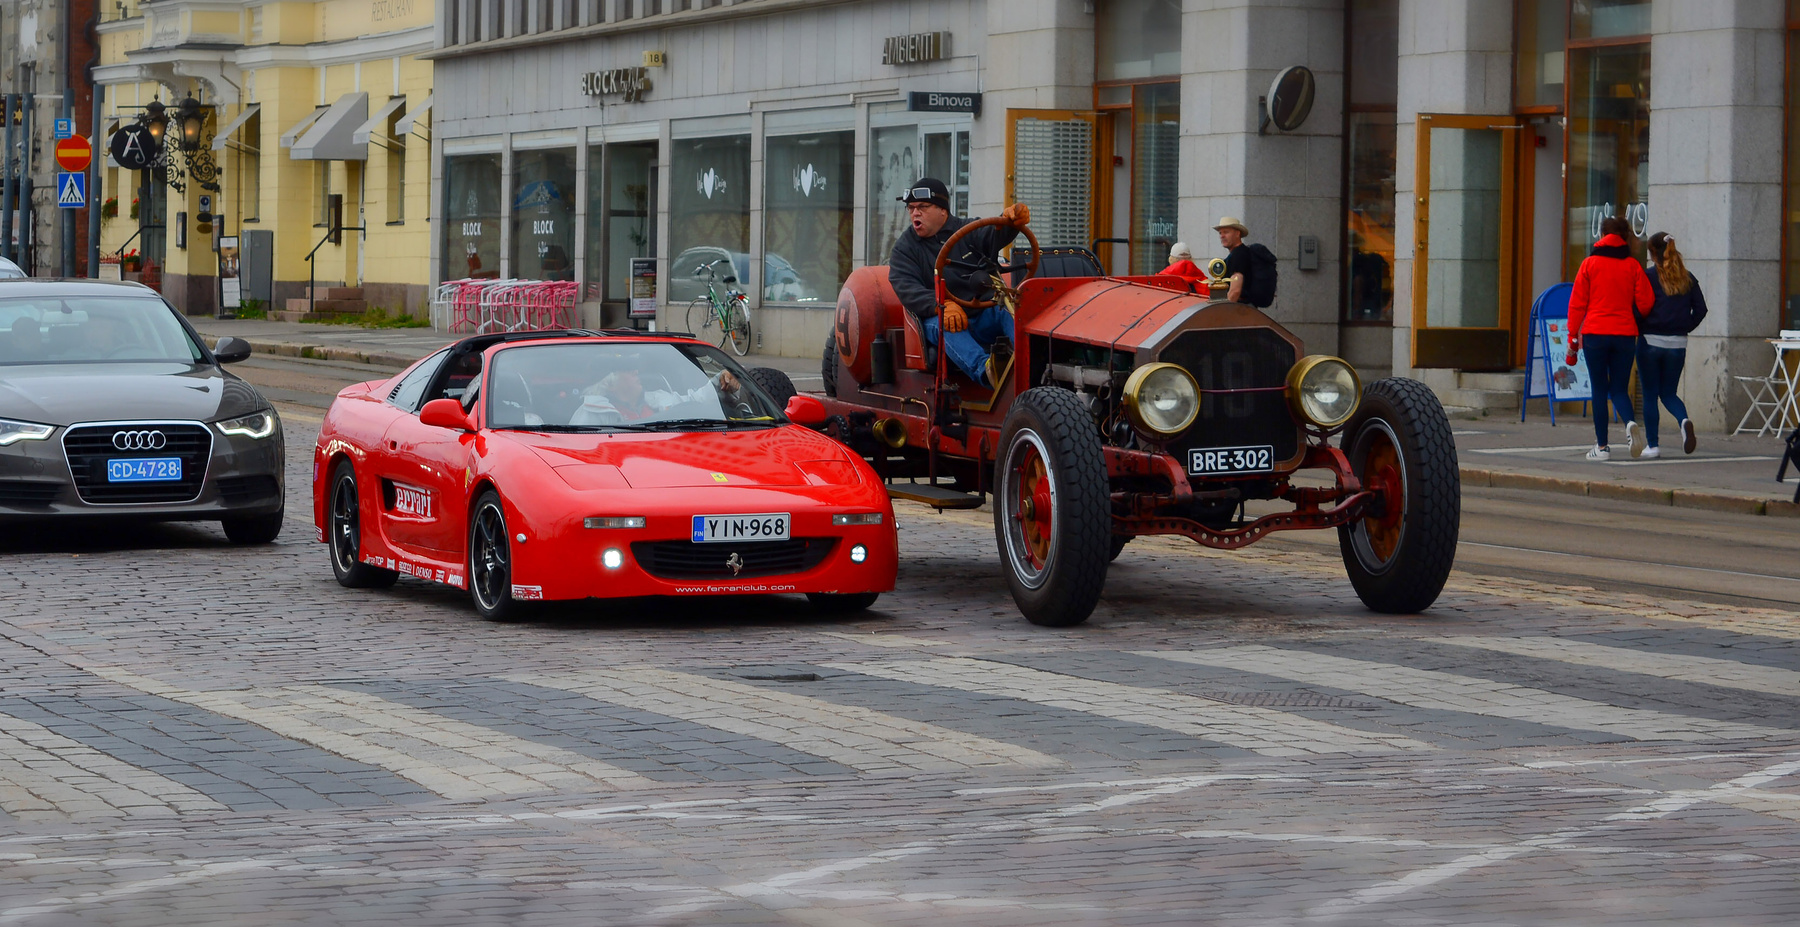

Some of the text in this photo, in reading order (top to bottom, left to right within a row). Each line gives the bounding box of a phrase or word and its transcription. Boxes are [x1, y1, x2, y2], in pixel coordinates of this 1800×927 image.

[371, 0, 414, 22] RESTAURANT
[650, 54, 660, 63] 18
[581, 70, 618, 95] BLOCK
[928, 94, 972, 107] Binova
[122, 131, 146, 164] A
[463, 222, 482, 236] BLOCK
[533, 220, 554, 234] BLOCK
[1146, 217, 1174, 237] Amber
[837, 300, 852, 357] 9
[392, 481, 431, 517] errari
[708, 518, 785, 537] YIN-968
[415, 566, 432, 579] DENSO
[675, 584, 796, 593] www.ferrariclub.com
